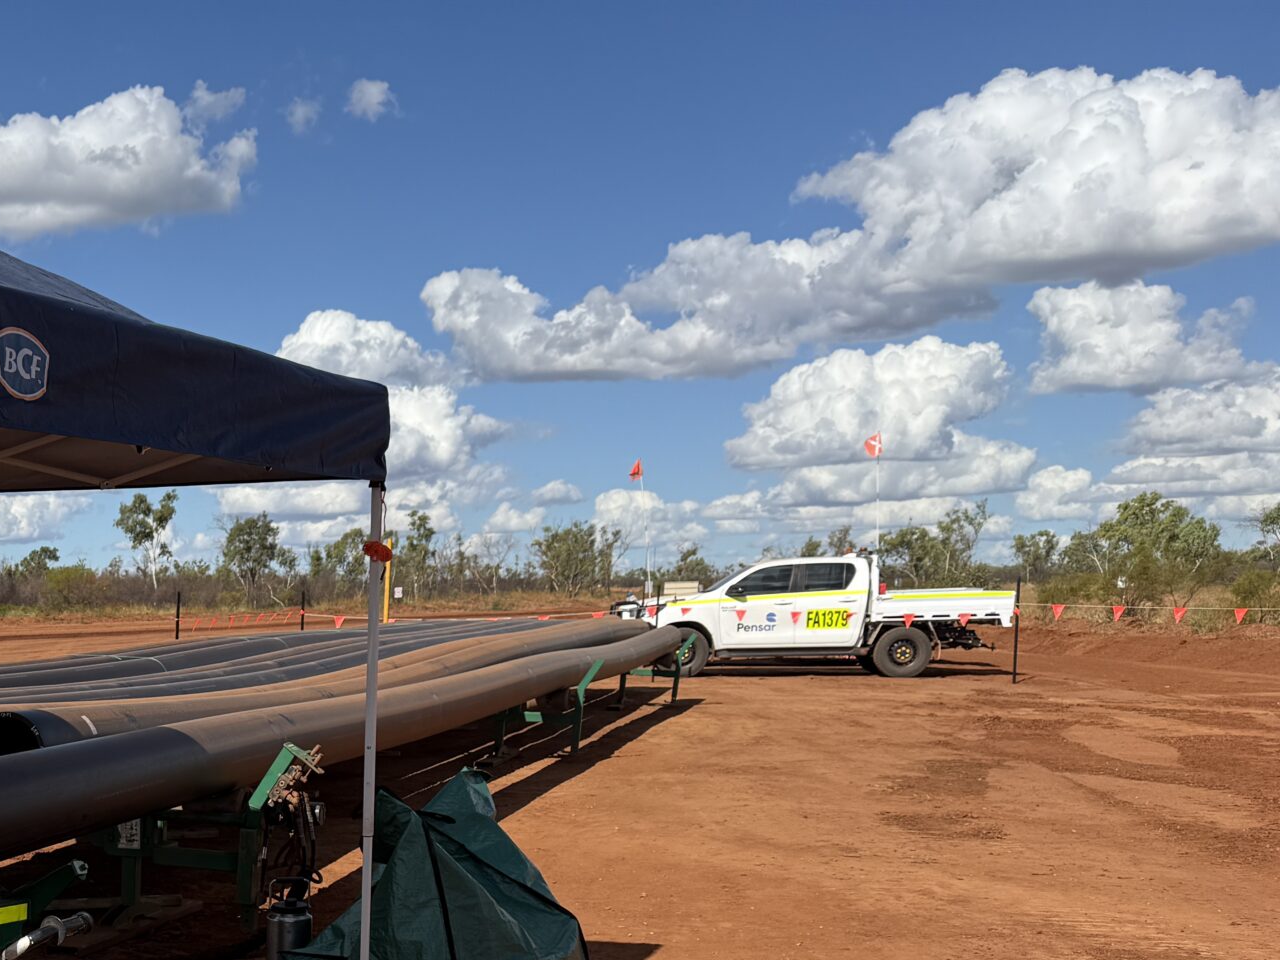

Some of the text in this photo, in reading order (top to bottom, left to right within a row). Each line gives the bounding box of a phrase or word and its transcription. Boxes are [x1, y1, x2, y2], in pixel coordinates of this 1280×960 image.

[4, 346, 41, 379] BCF
[737, 623, 776, 632] Pensar
[806, 610, 848, 628] FA1379
